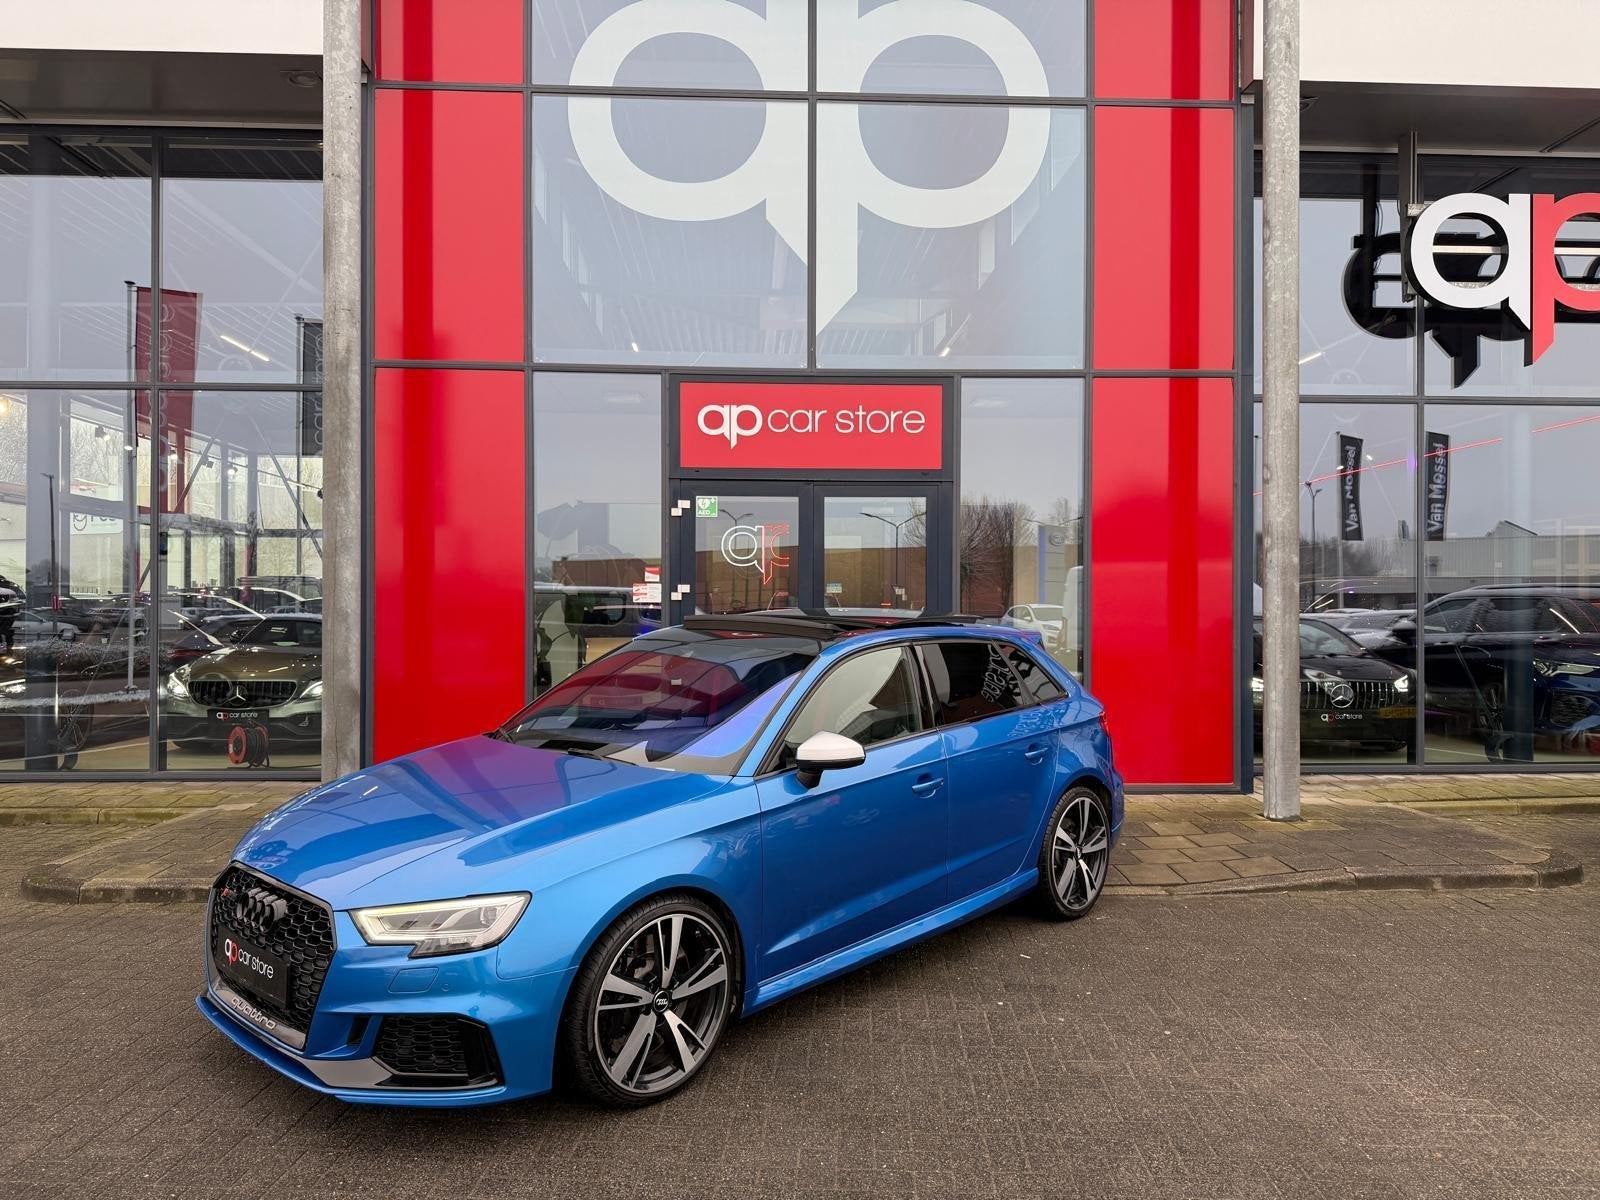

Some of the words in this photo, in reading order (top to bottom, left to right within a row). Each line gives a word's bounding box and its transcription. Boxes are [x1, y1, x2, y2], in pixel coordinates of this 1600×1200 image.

[697, 404, 763, 449] ap
[767, 409, 827, 433] car
[835, 405, 926, 433] store
[1429, 442, 1447, 499] Mossel
[1346, 503, 1360, 532] Van
[1427, 503, 1445, 533] Van
[238, 949, 252, 965] car
[251, 955, 274, 979] store
[231, 996, 276, 1030] quattro
